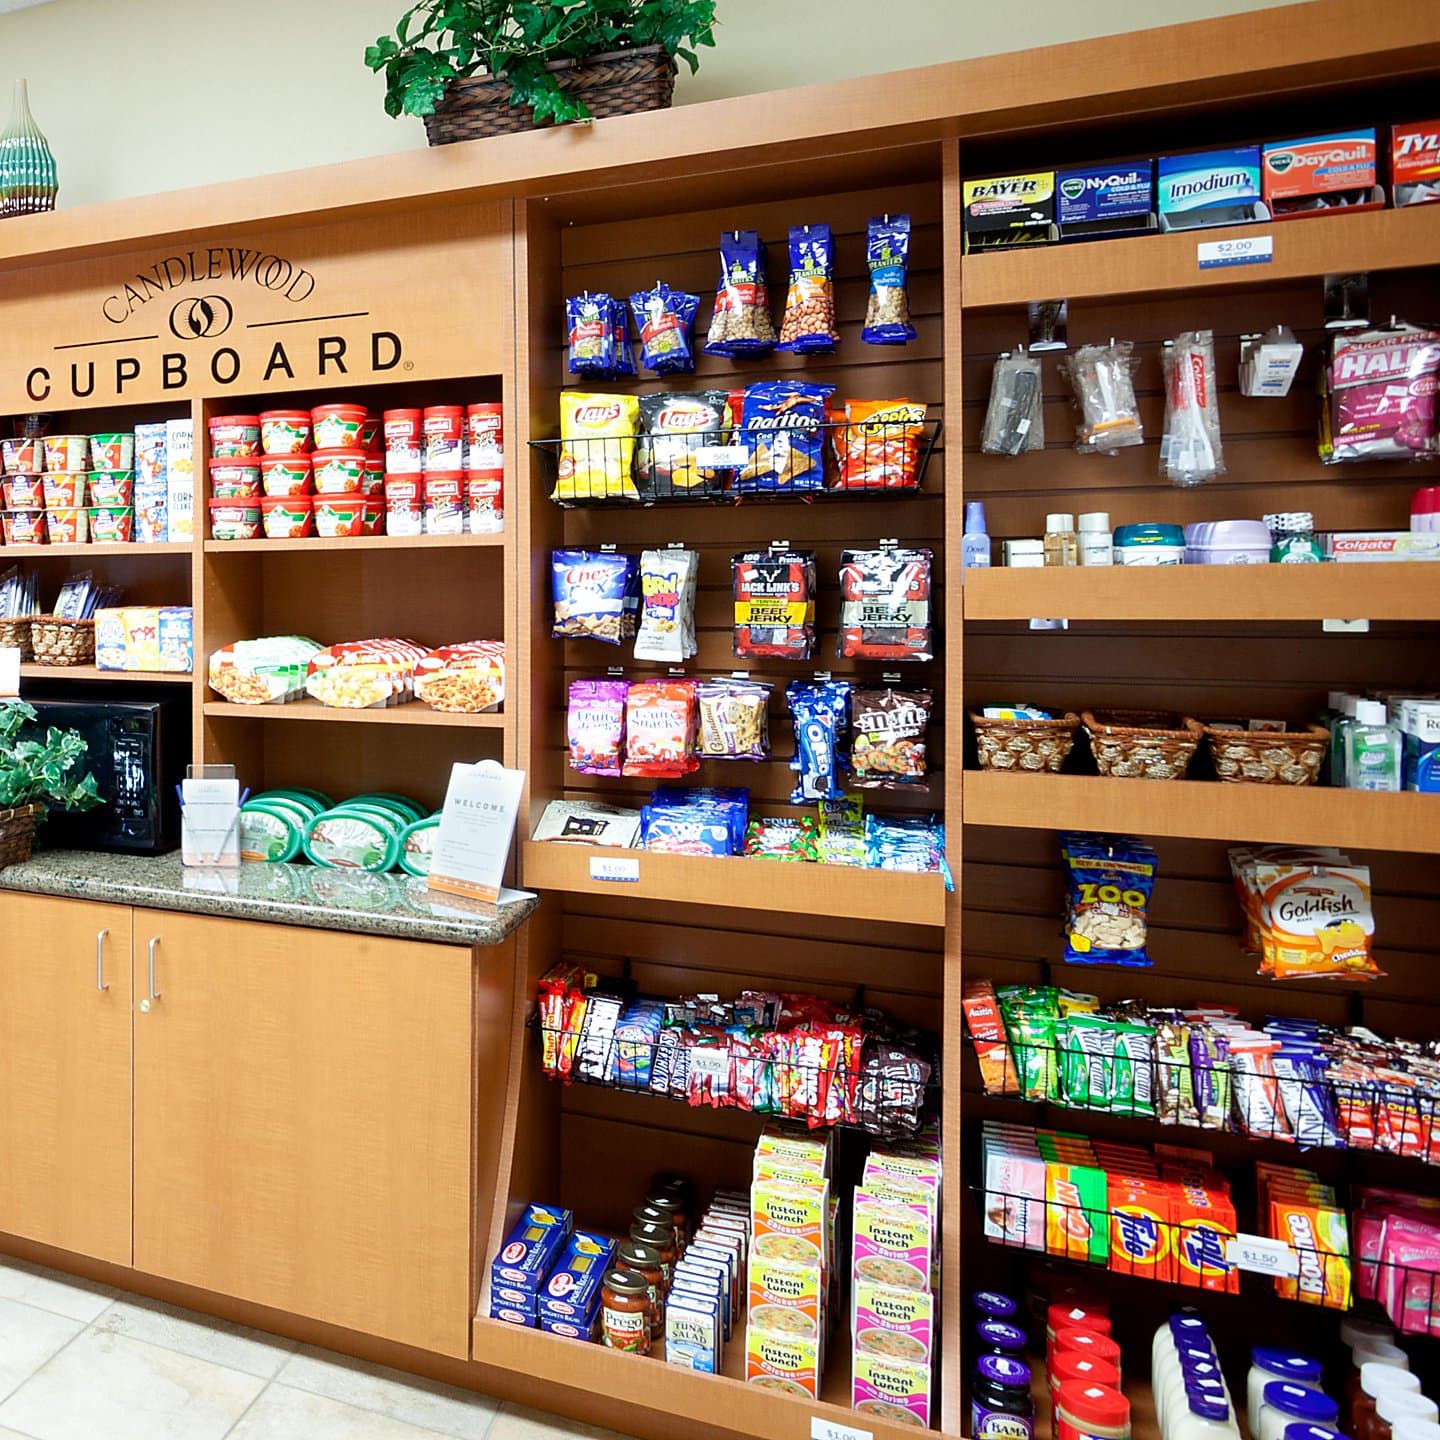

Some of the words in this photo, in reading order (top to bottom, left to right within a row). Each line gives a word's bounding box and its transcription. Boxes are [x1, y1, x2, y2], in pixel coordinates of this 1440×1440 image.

[1293, 146, 1367, 168] DayQuil
[972, 180, 1037, 198] BAYER
[1086, 173, 1138, 190] NyQuil
[1171, 171, 1247, 198] Imodium
[1217, 241, 1252, 253] $2.00
[102, 248, 316, 324] CANDLEWOOD
[1351, 338, 1397, 351] SUGAR
[26, 332, 402, 401] CUPBOARD
[1335, 540, 1393, 552] Colgate
[778, 556, 804, 564] Protein
[566, 566, 610, 585] Chex
[766, 581, 800, 593] LINK'S
[746, 614, 793, 623] JERKY
[750, 607, 787, 615] BEEF
[858, 613, 913, 623] JERKY
[455, 798, 505, 813] WELCOME
[1078, 883, 1147, 907] ZOO
[1280, 894, 1353, 920] Goldfish
[969, 1007, 993, 1017] Austin
[652, 1035, 676, 1089] SNICKERS
[766, 1202, 808, 1216] Instant
[771, 1212, 804, 1223] Lunch
[869, 1225, 914, 1241] Instant
[873, 1235, 909, 1248] Lunch
[1243, 1250, 1278, 1264] $1.50
[1288, 1213, 1328, 1295] Bounce
[762, 1274, 805, 1289] Instant
[767, 1283, 800, 1295] Lunch
[871, 1298, 916, 1313] Instant
[606, 1311, 642, 1331] Prego
[876, 1307, 911, 1321] Lunch
[675, 1322, 704, 1335] TUNA
[672, 1331, 707, 1344] SALAD
[761, 1345, 802, 1361] Instant
[765, 1354, 798, 1368] Lunch
[869, 1369, 913, 1387] Instant
[873, 1379, 909, 1394] Lunch
[991, 1421, 1027, 1437] BAMA
